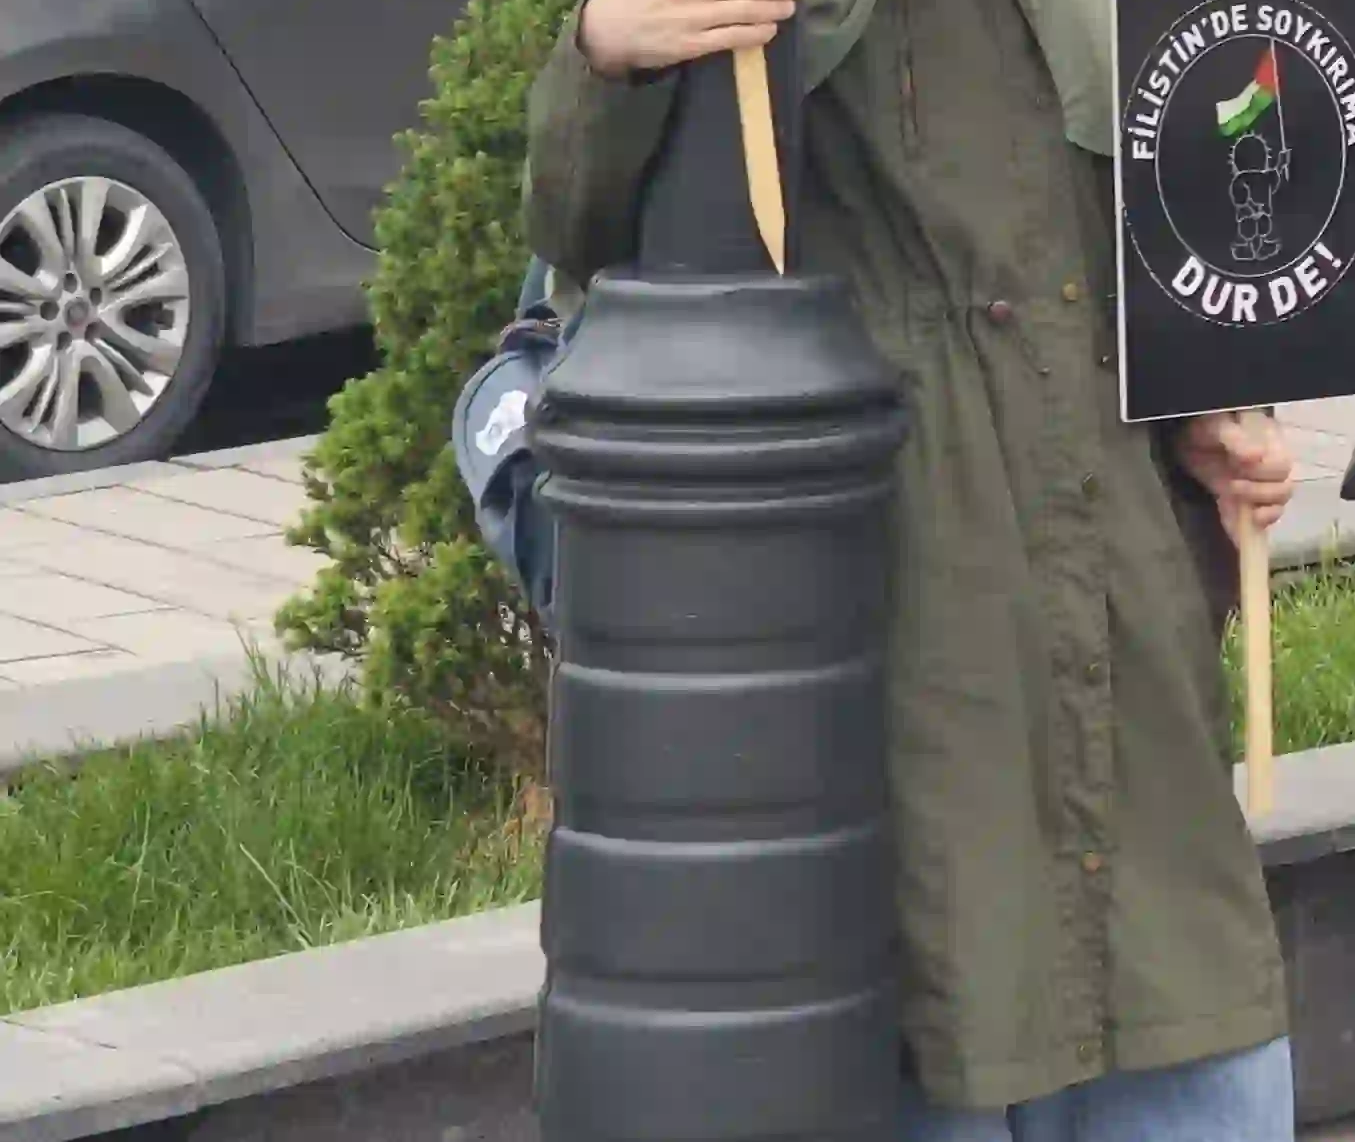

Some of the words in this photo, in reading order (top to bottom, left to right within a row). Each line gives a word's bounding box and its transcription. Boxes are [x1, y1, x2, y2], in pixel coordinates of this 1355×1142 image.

[1128, 4, 1248, 160] FİLİSTİN'DE
[1172, 255, 1258, 322] DUR
[1269, 241, 1342, 320] DE!
